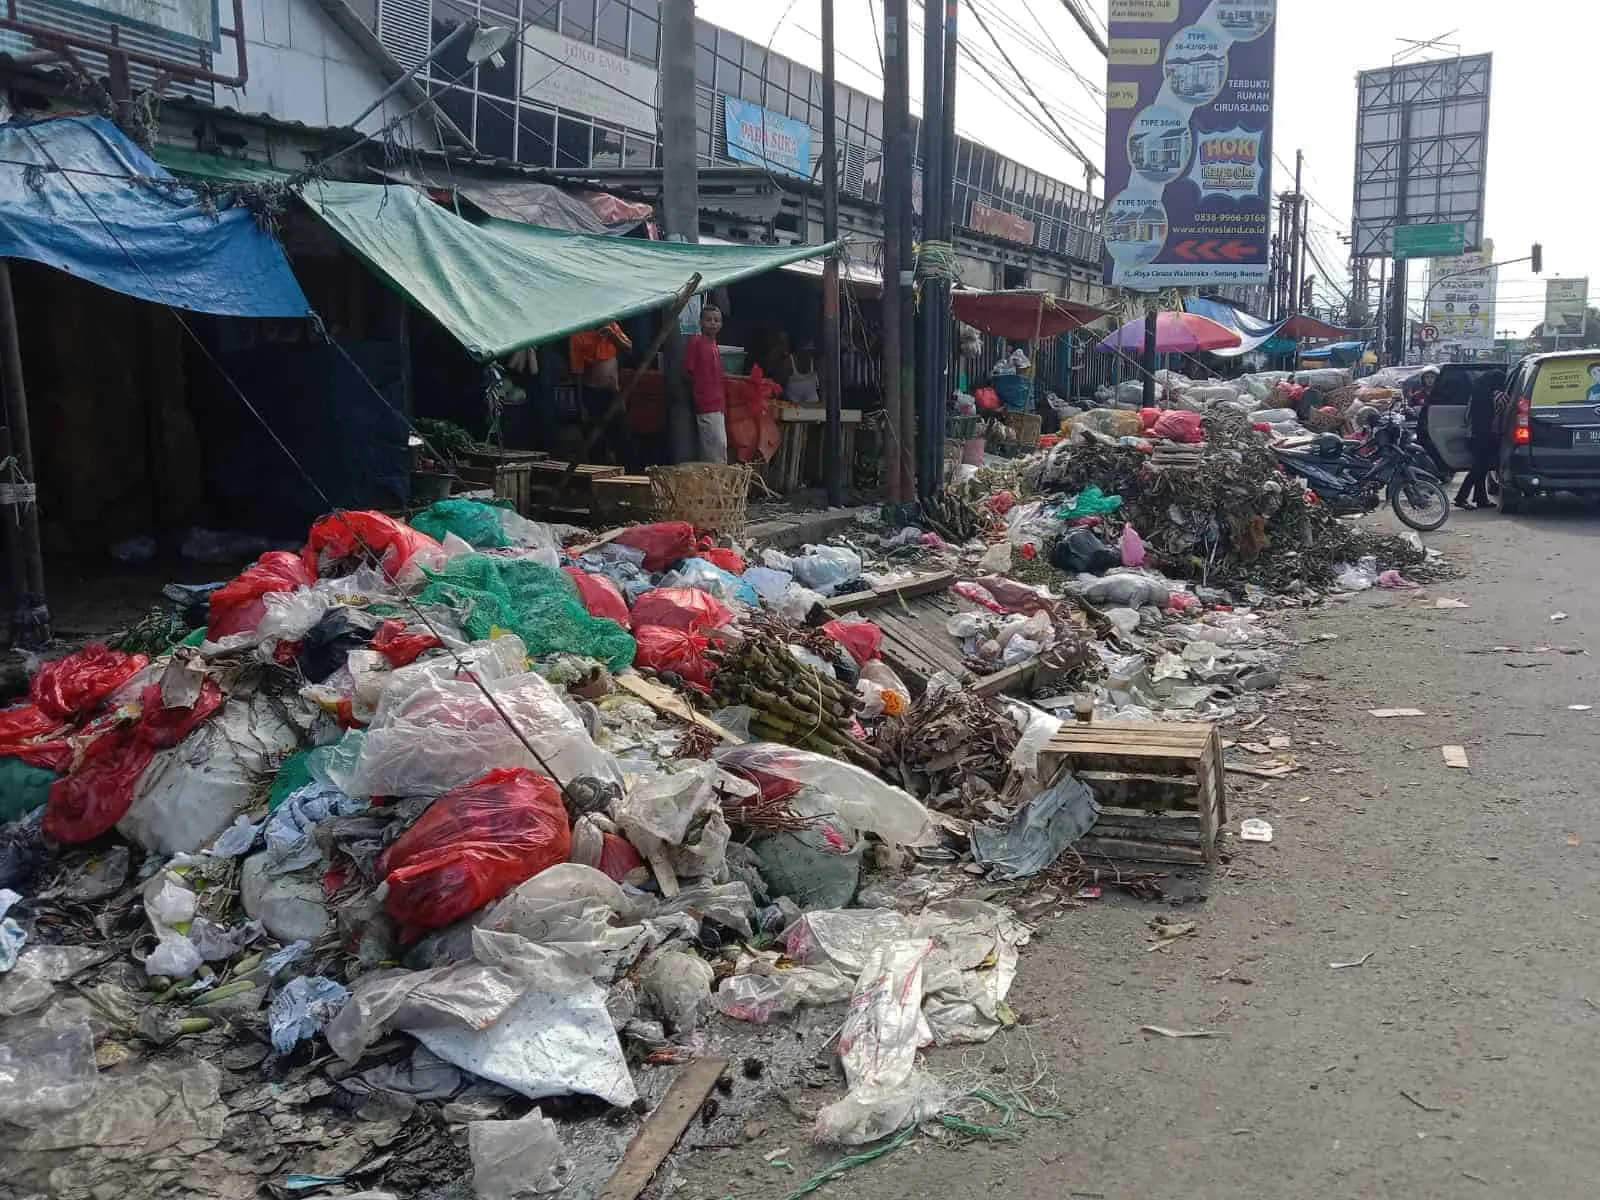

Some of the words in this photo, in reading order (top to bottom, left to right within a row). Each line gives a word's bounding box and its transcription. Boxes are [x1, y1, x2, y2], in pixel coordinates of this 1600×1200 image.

[1187, 32, 1206, 41] TYPE
[1227, 79, 1271, 88] TERBUKTI
[1236, 91, 1270, 100] RUMAH
[1213, 103, 1270, 112] CIRUASLAND
[1140, 119, 1160, 127] TYPE
[1117, 199, 1137, 207] TYPE
